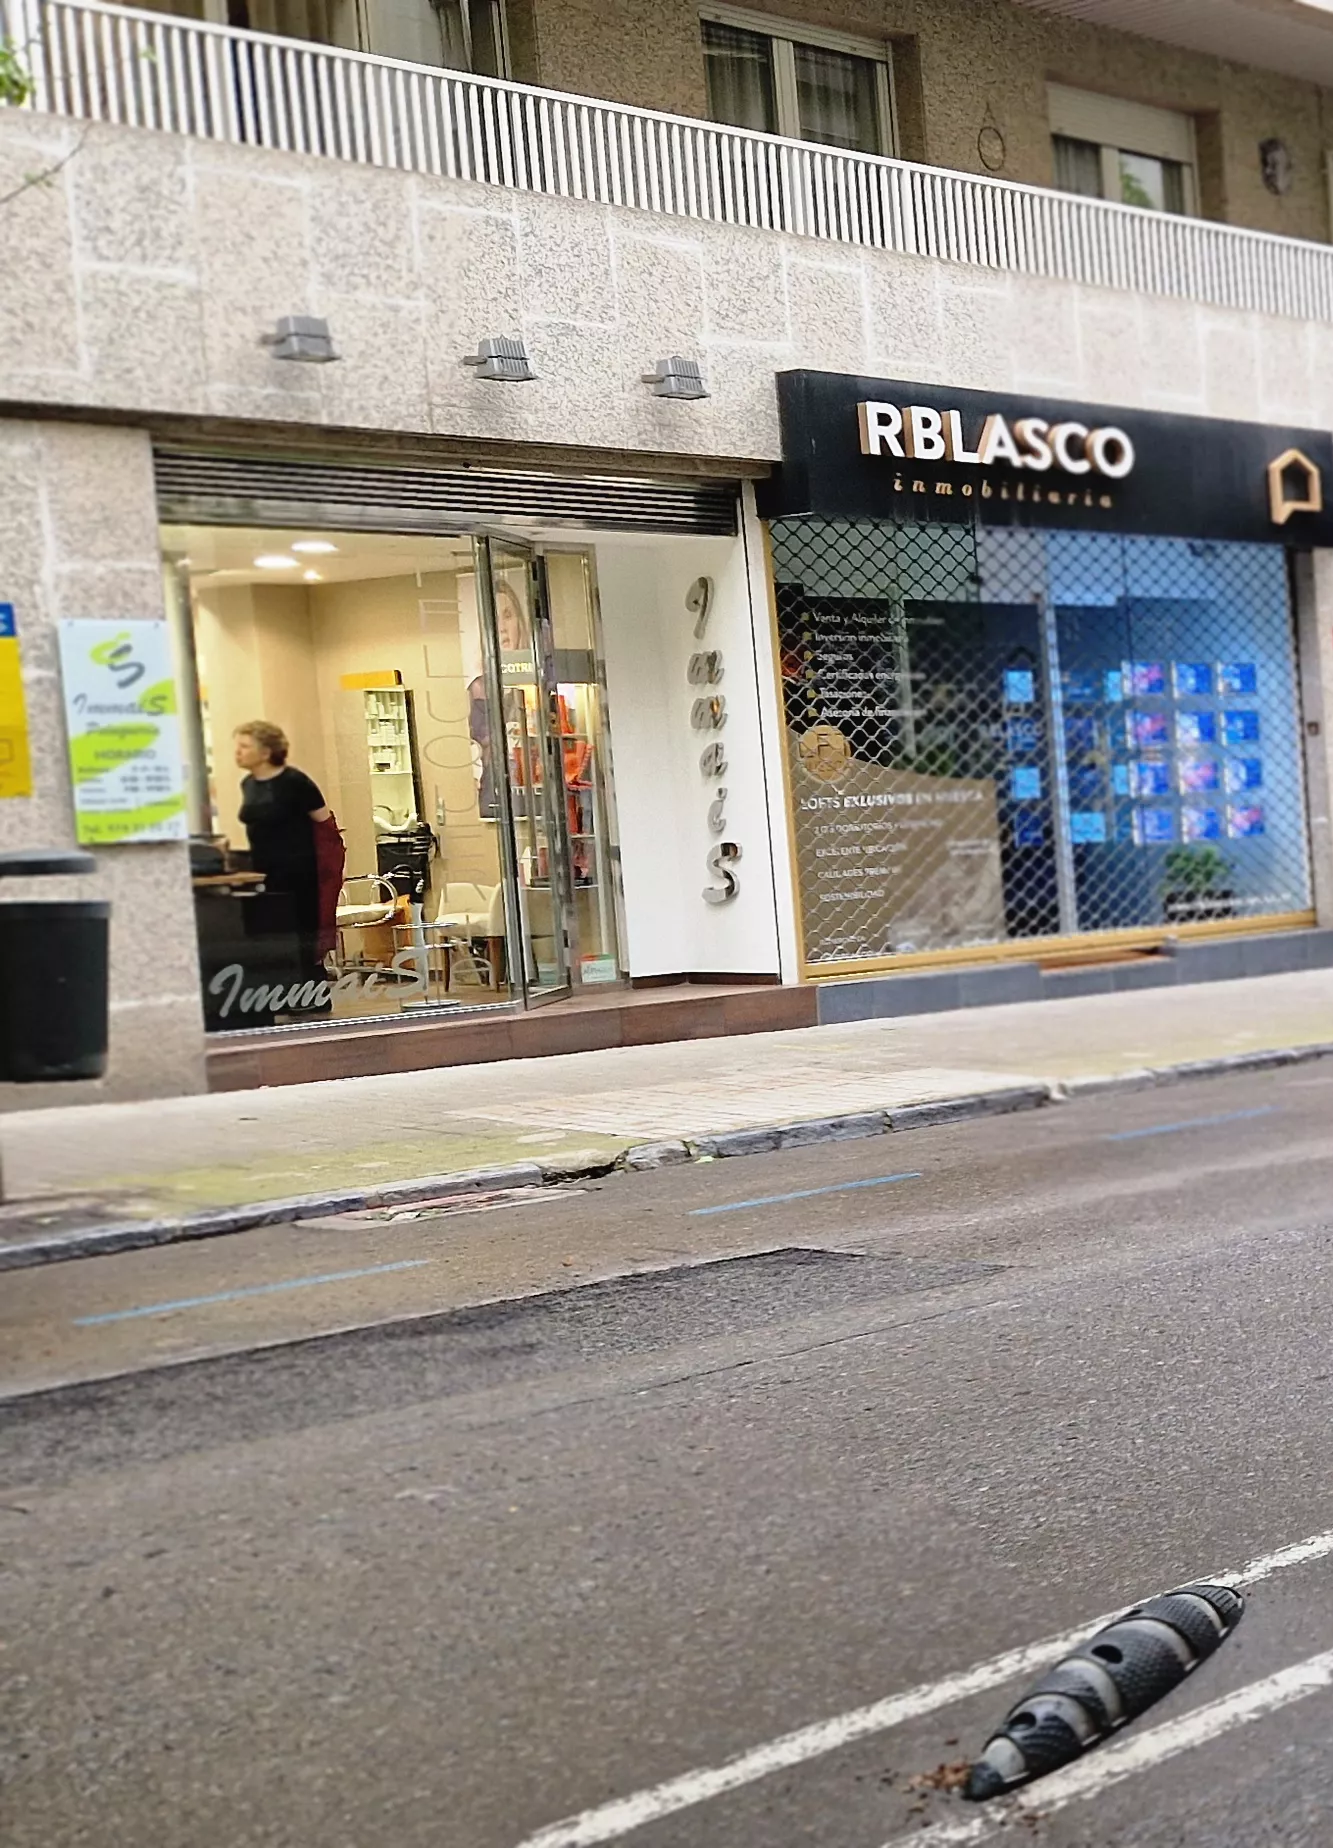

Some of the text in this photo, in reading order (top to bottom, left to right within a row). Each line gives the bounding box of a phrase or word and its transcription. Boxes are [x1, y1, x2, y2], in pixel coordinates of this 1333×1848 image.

[857, 401, 1135, 479] RBLASCO
[893, 473, 1113, 508] inmobiliaria
[801, 796, 841, 811] LOFTS
